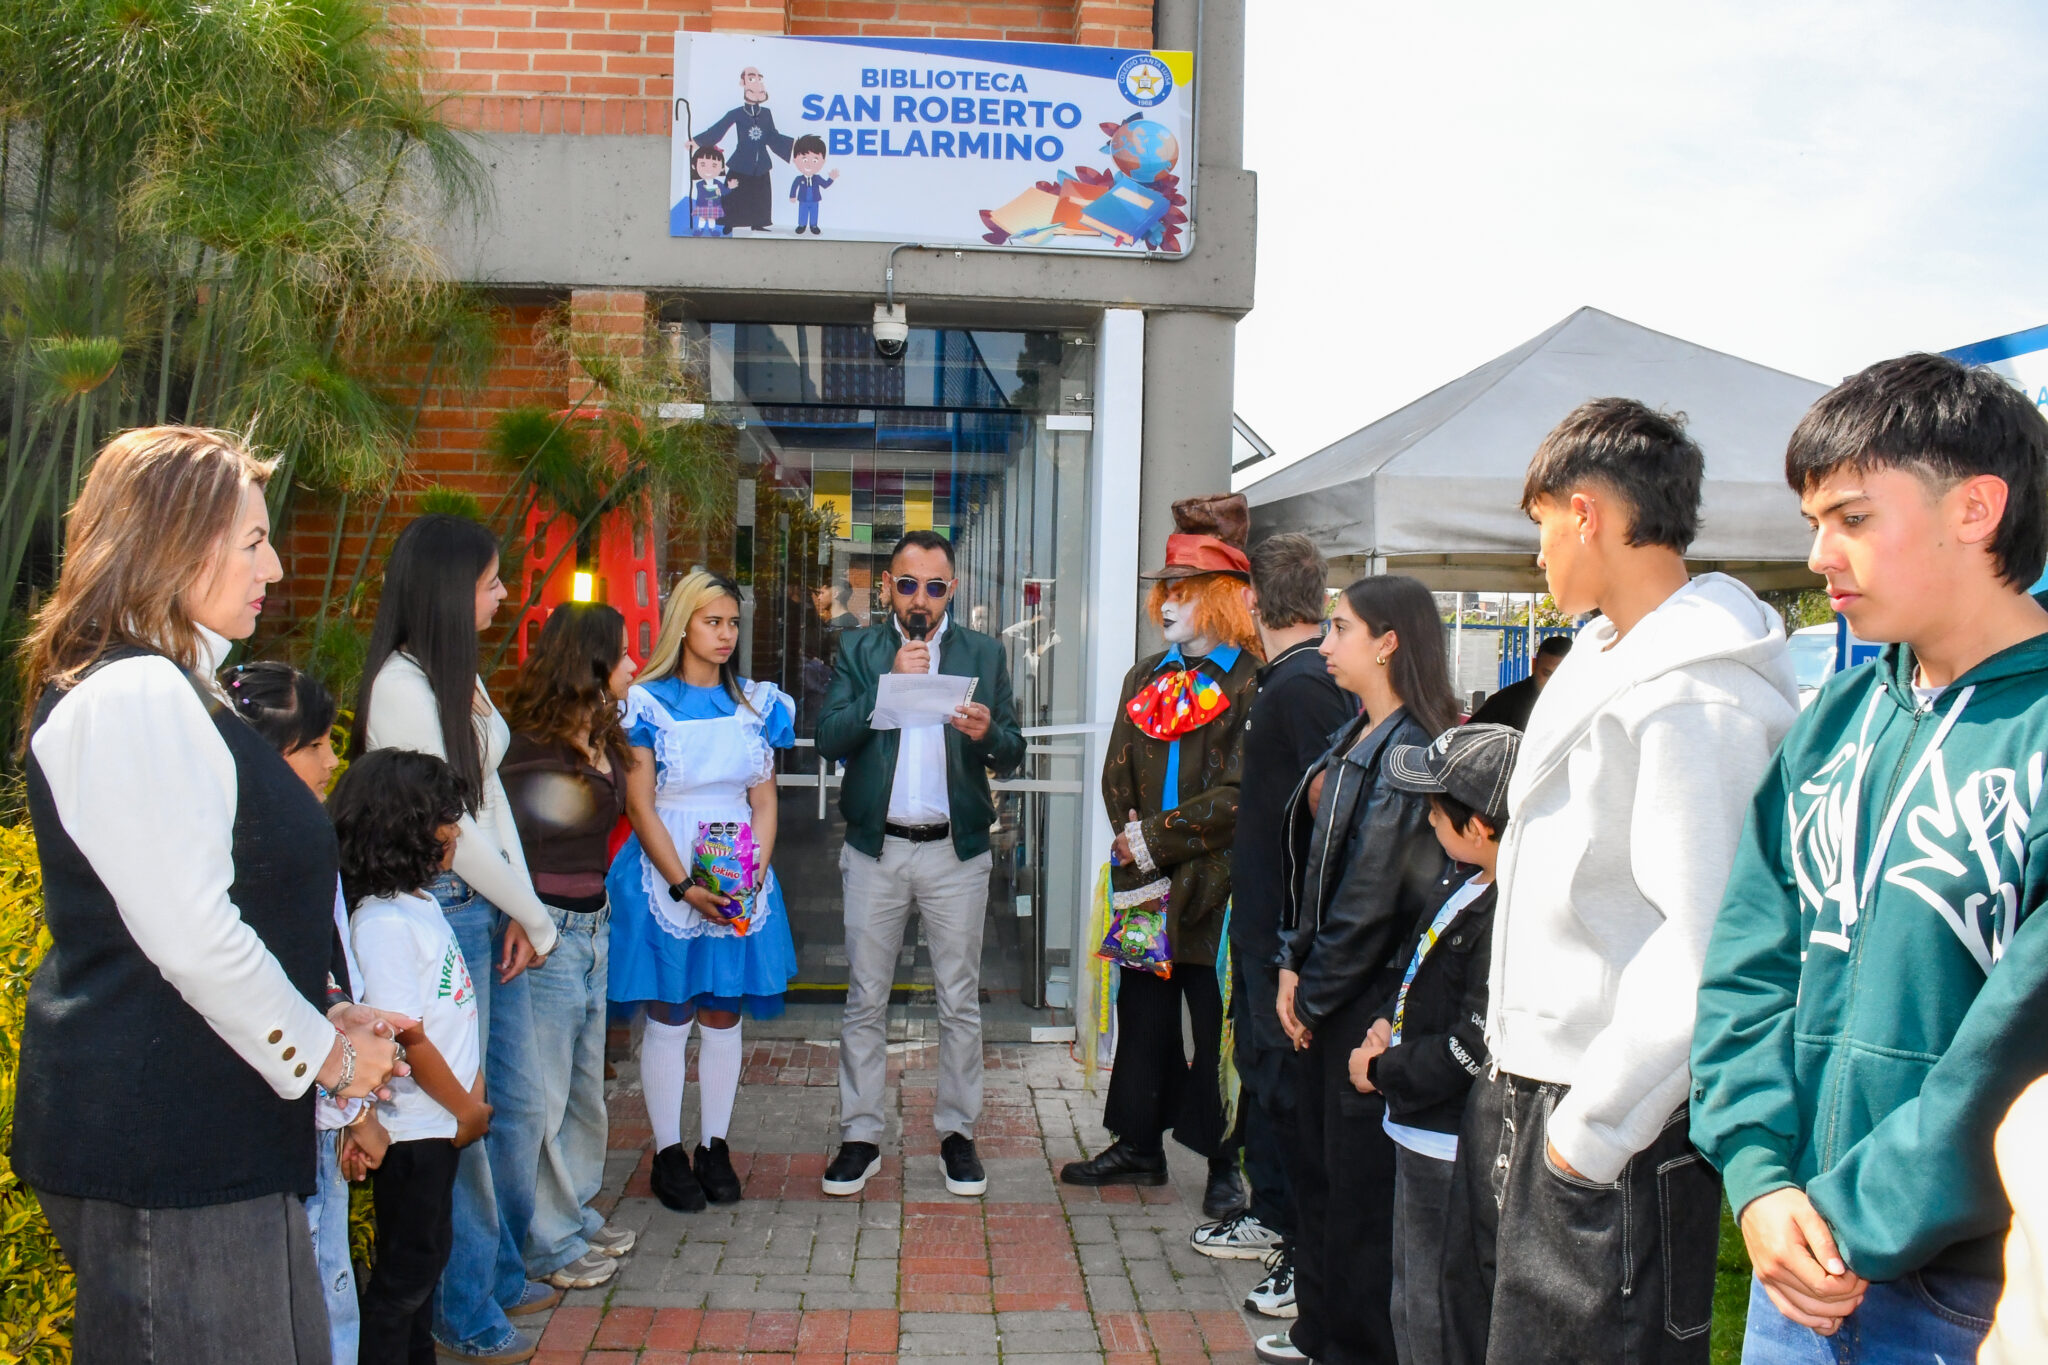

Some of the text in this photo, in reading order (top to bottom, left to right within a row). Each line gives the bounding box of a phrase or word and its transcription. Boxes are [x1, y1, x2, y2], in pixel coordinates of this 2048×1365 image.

[861, 68, 1028, 93] BIBLIOTECA
[1120, 58, 1138, 84] COLEGIO
[1139, 57, 1161, 68] SANTA
[801, 93, 1082, 129] SAN ROBERTO
[829, 128, 1064, 162] BELARMINO
[438, 944, 456, 999] THREE
